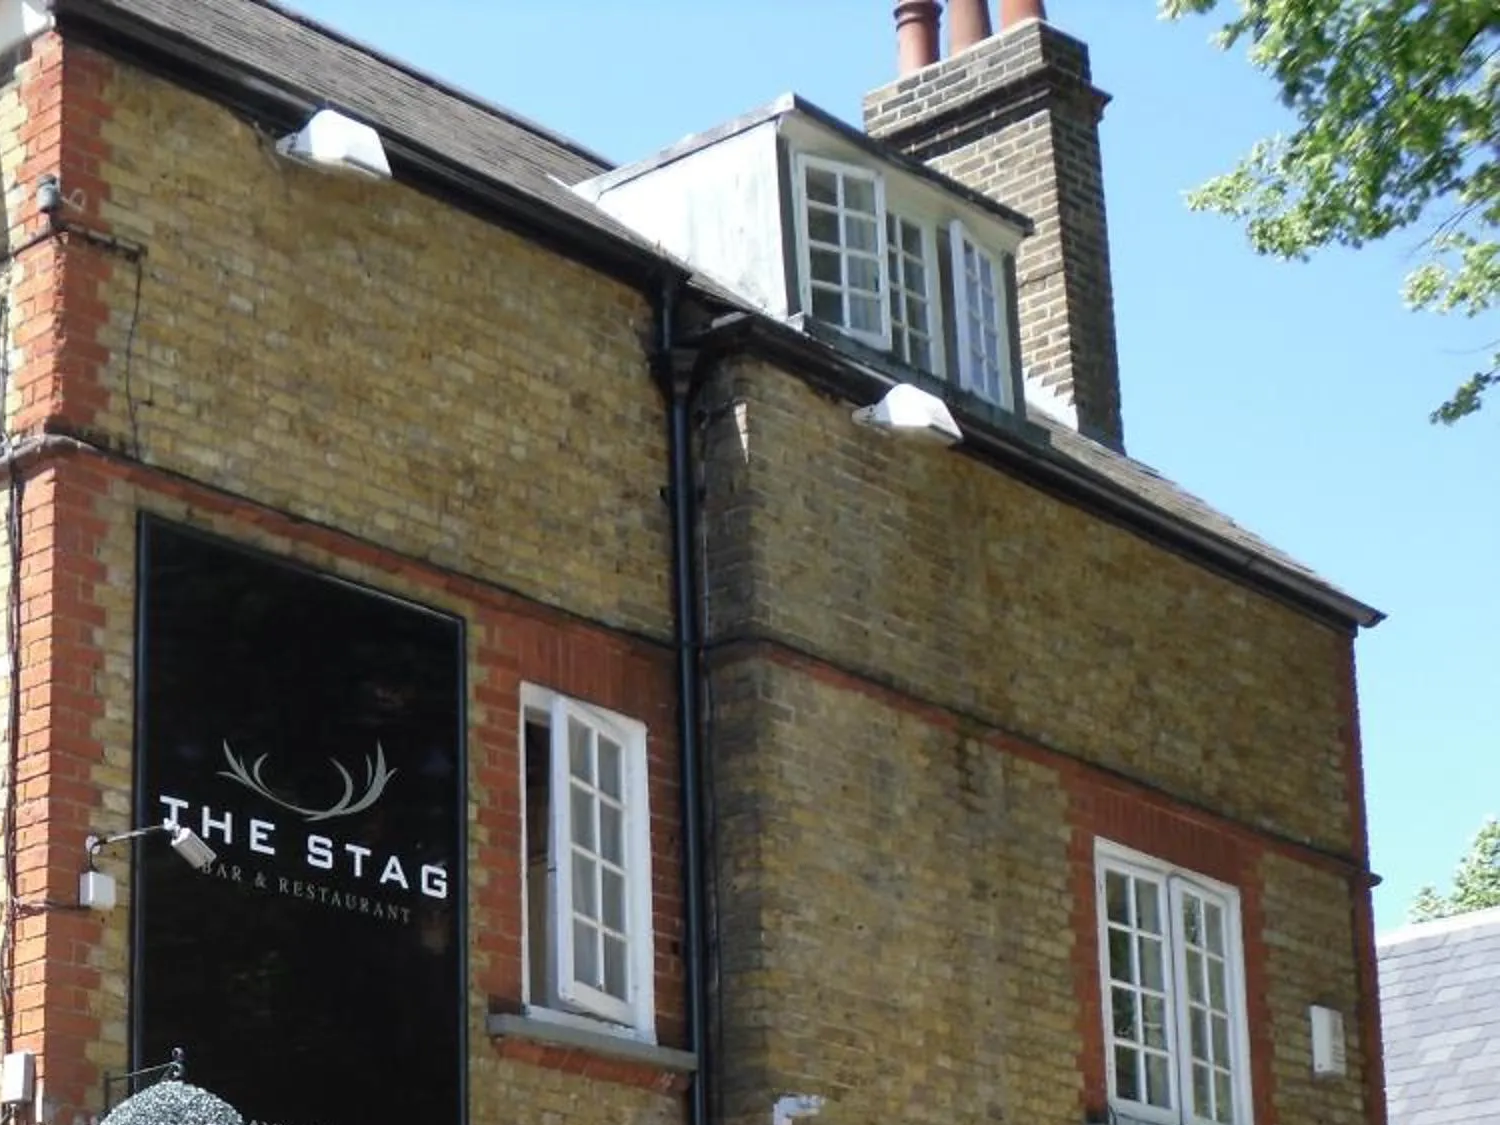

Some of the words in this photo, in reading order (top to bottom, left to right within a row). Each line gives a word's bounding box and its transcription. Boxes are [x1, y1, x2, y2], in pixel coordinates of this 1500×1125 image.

[159, 795, 276, 856] THE
[307, 834, 449, 900] STAG
[201, 860, 243, 882] BAR
[254, 872, 268, 890] &
[278, 877, 411, 925] RESTAURANT
